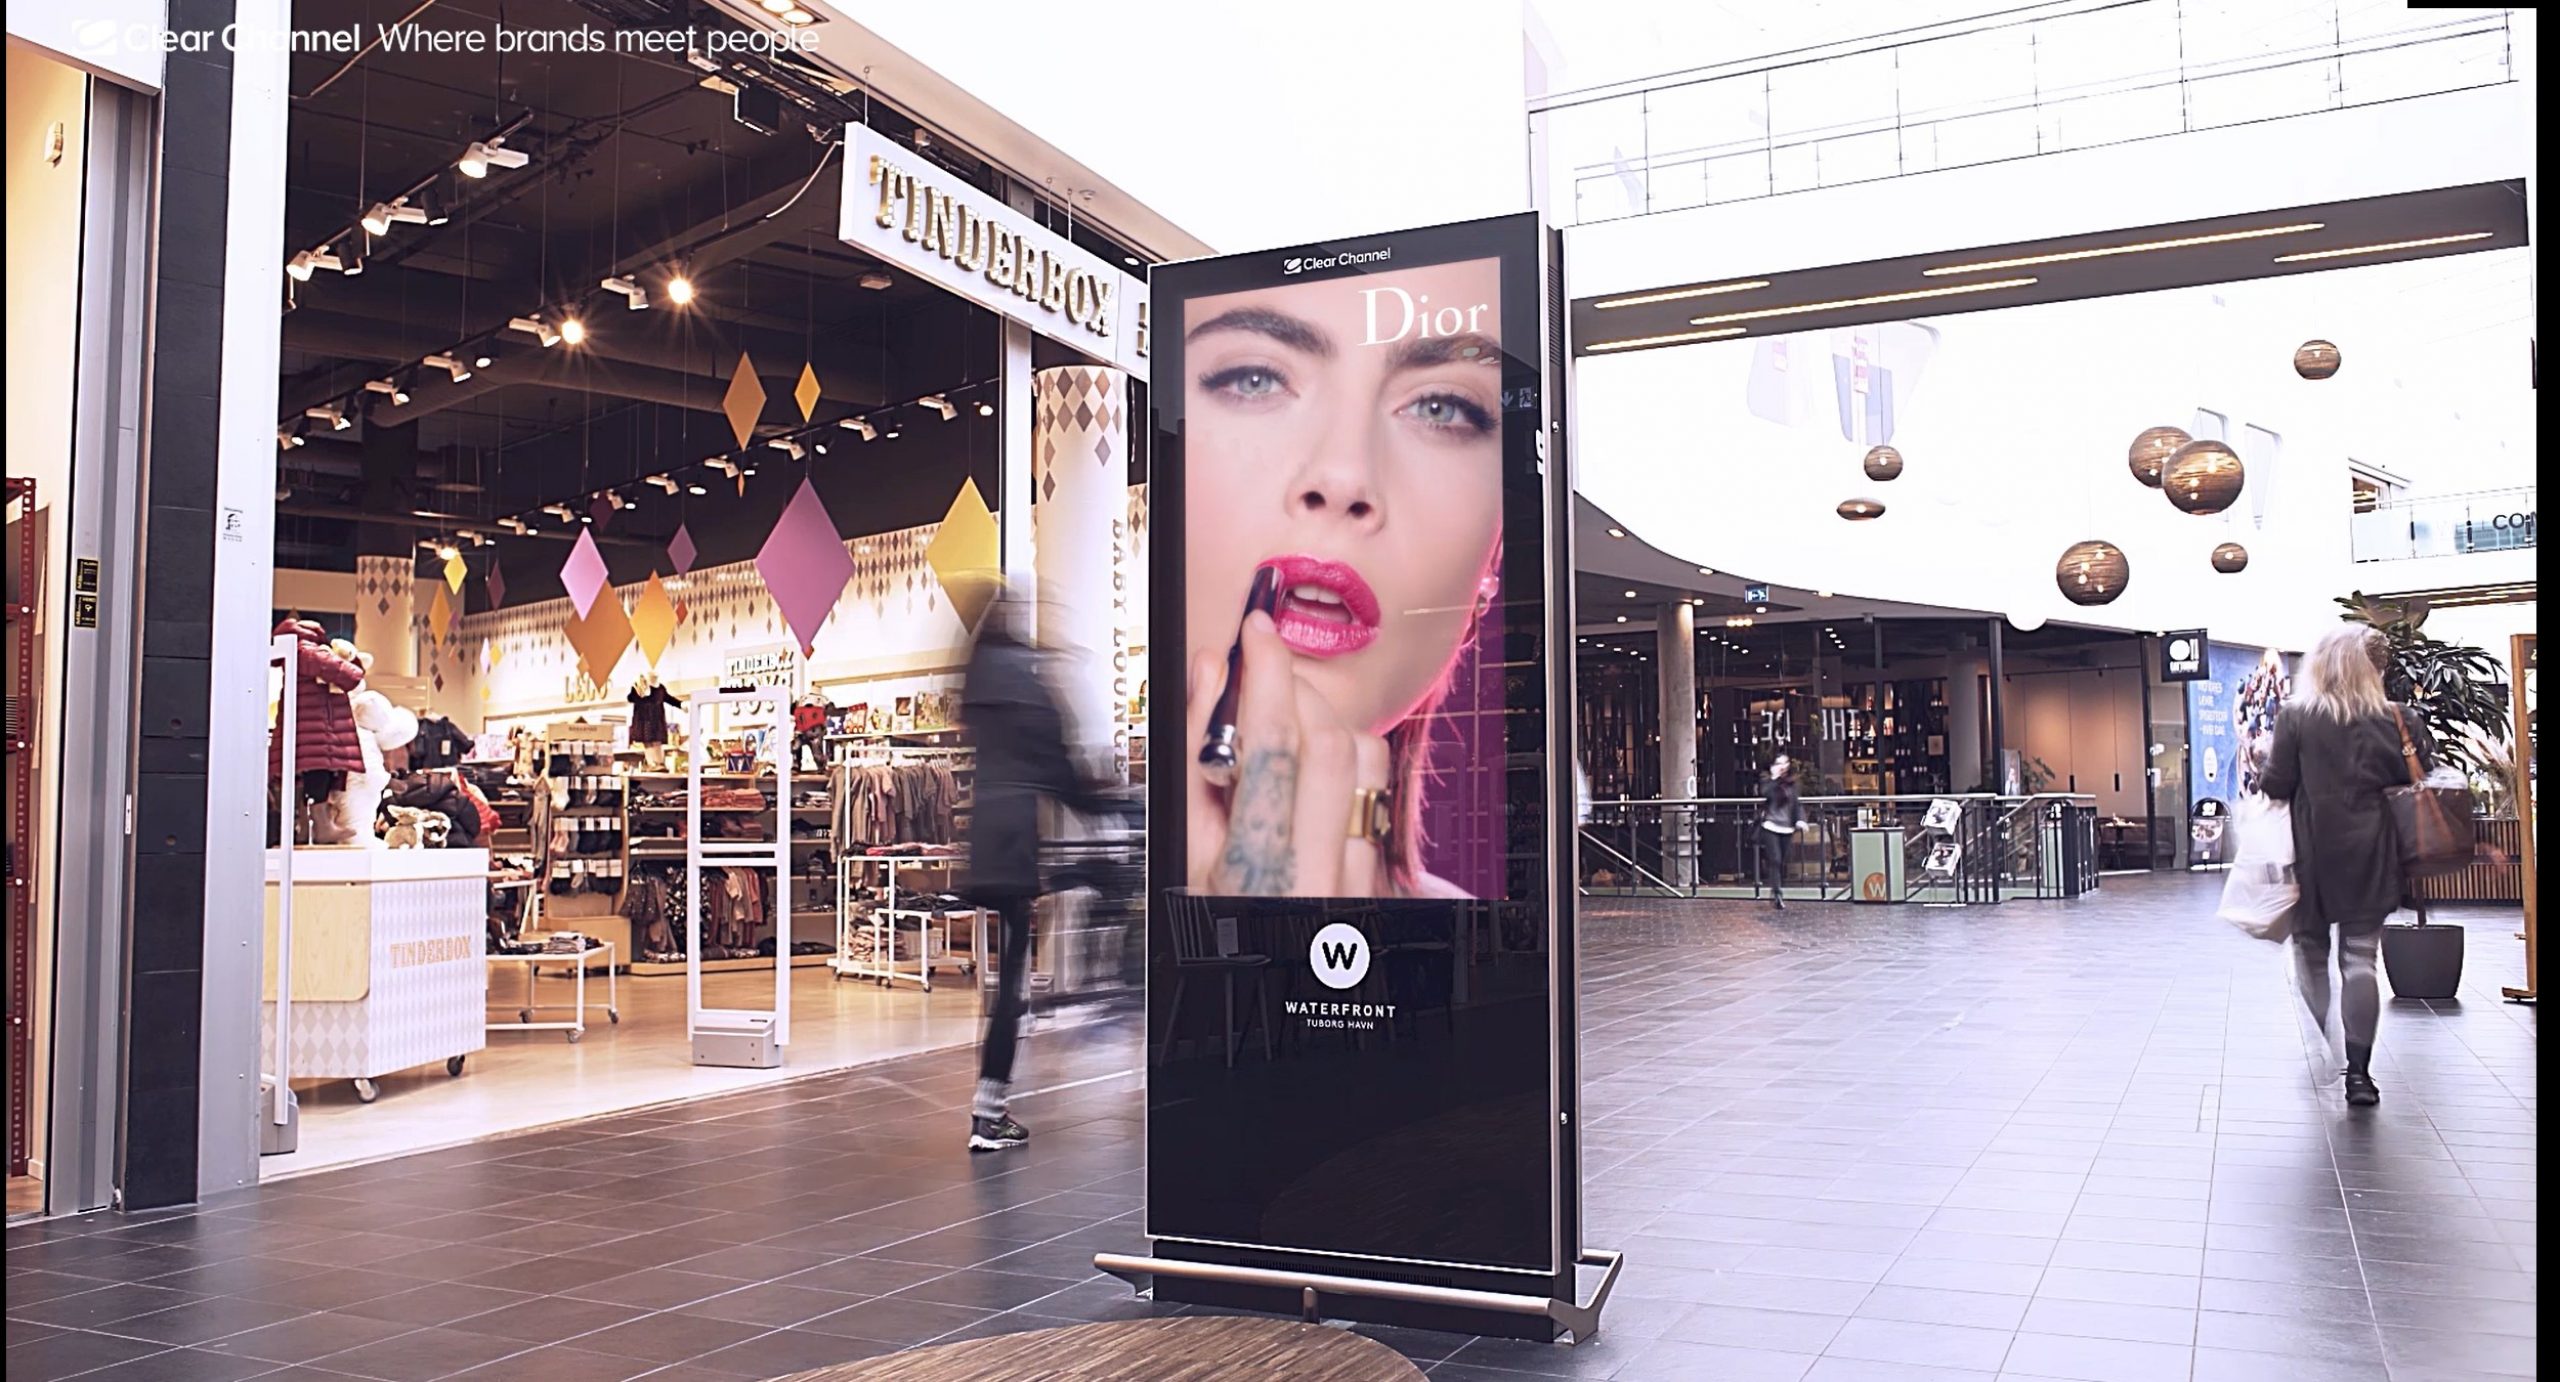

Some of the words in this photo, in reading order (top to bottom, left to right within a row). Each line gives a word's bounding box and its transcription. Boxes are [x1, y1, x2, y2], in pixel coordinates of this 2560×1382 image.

[869, 155, 1116, 337] TINDERBOX
[1303, 255, 1337, 271] Clear
[1338, 247, 1391, 266] Channel
[1357, 286, 1489, 346] Dior
[1112, 627, 1128, 775] LOUNGE
[390, 934, 471, 969] TINDERBOX
[1321, 941, 1358, 971] W
[1285, 1000, 1396, 1018] WATERFRONT
[1306, 1018, 1345, 1029] TUBORG
[1347, 1020, 1374, 1030] HAVN
